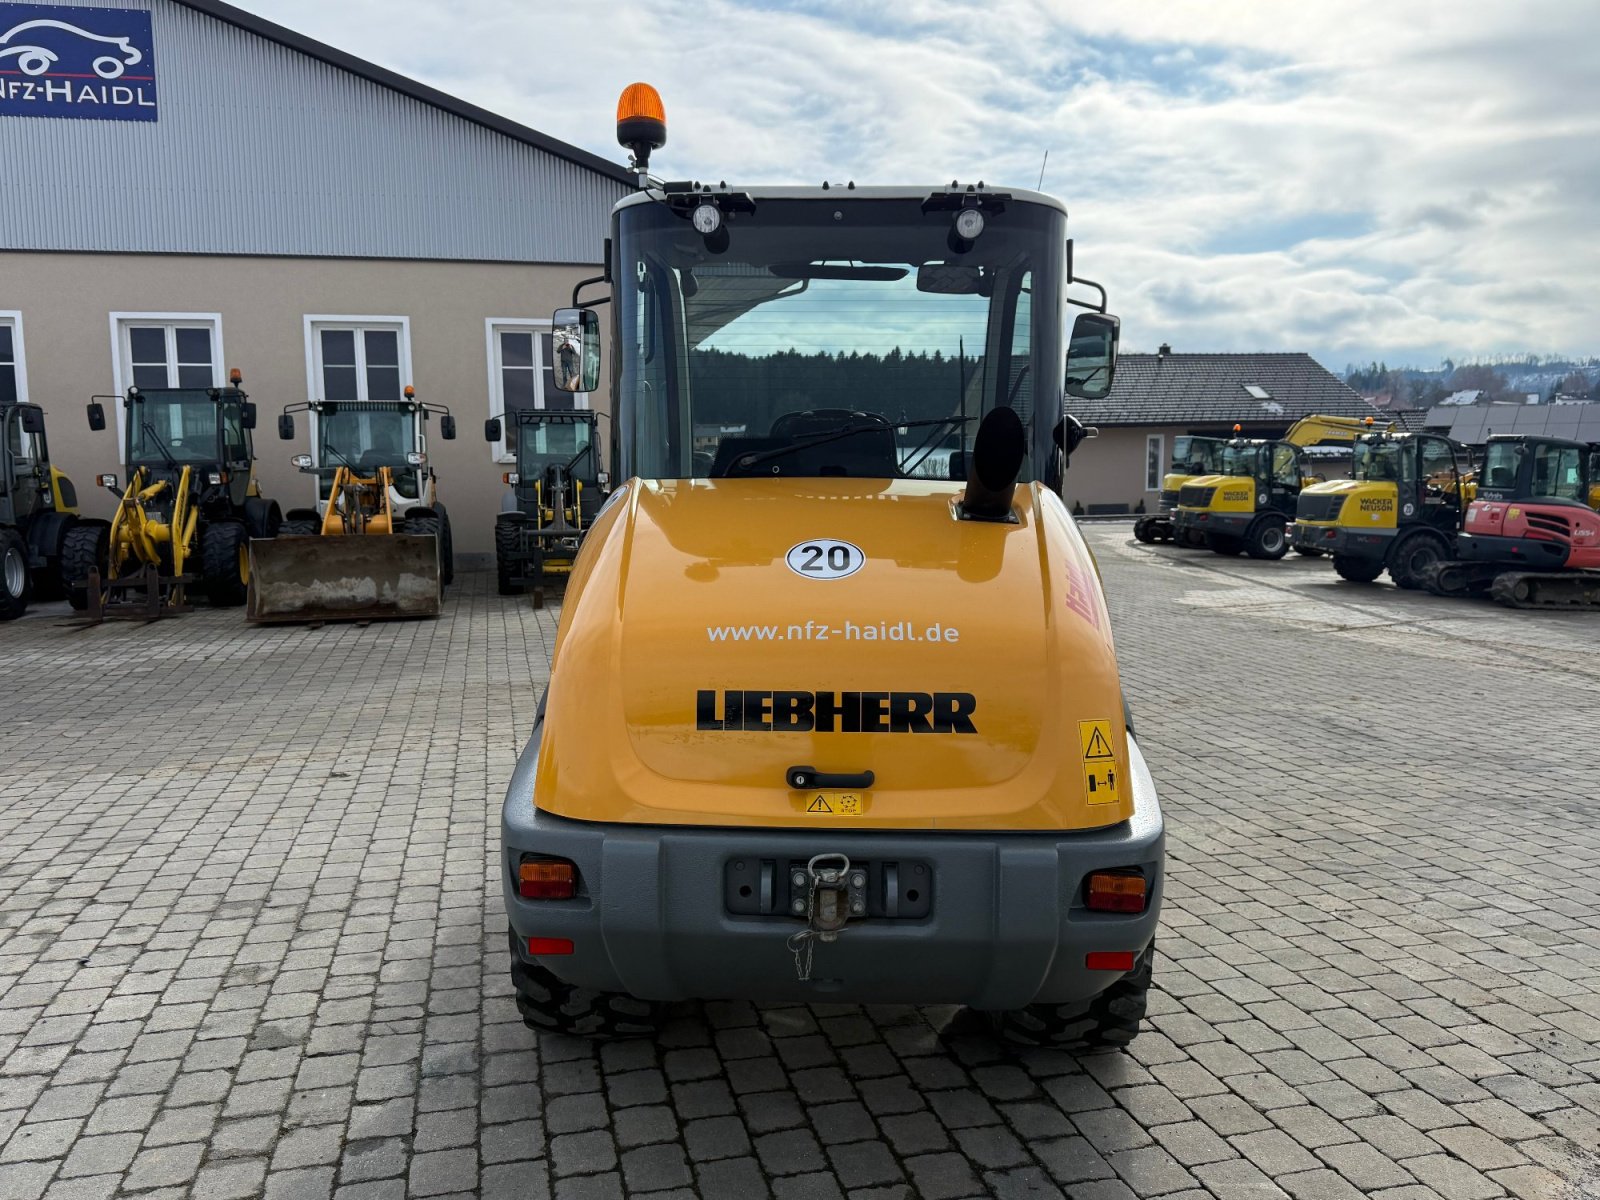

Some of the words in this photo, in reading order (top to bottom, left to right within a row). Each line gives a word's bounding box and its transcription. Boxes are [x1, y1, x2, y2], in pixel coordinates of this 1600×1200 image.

[800, 545, 851, 571] 20
[706, 620, 960, 643] www.nfz-haidl.de
[696, 689, 979, 734] LIEBHERR
